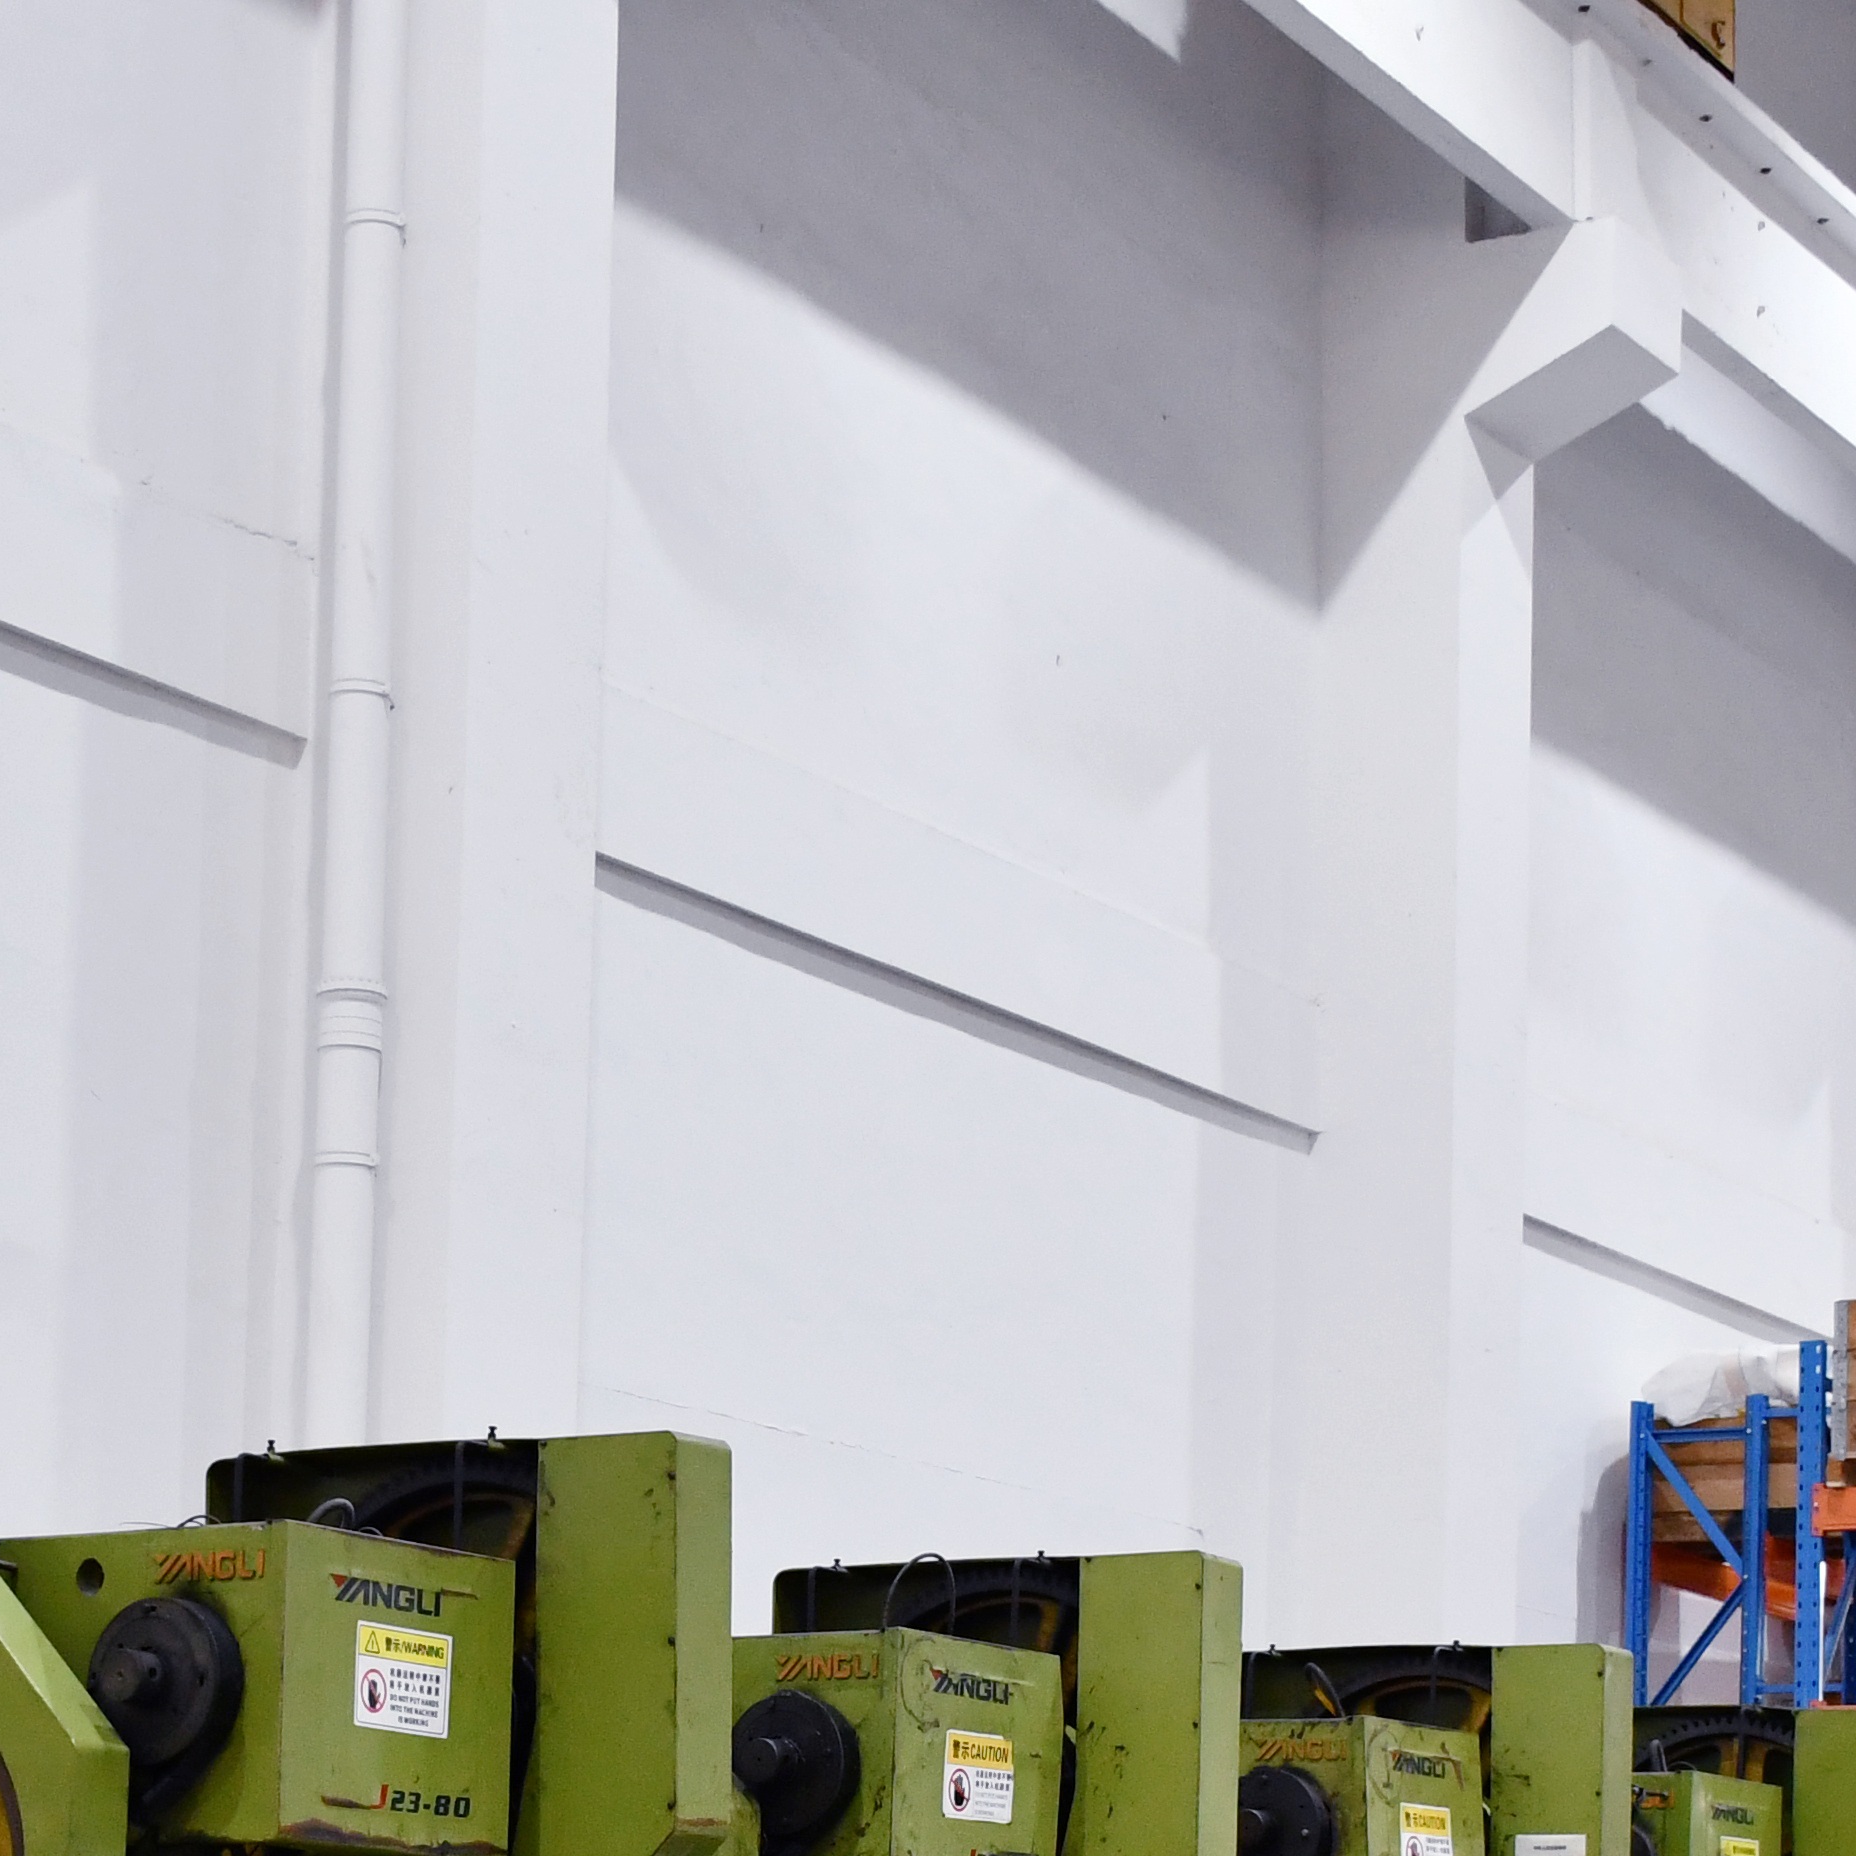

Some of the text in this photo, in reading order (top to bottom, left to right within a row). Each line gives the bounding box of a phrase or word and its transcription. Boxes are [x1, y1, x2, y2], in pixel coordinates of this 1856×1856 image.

[154, 1548, 265, 1584] YANGLI
[330, 1573, 442, 1617] YANGLI
[775, 1653, 879, 1682] YANGLI
[370, 1784, 470, 1818] J23-80
